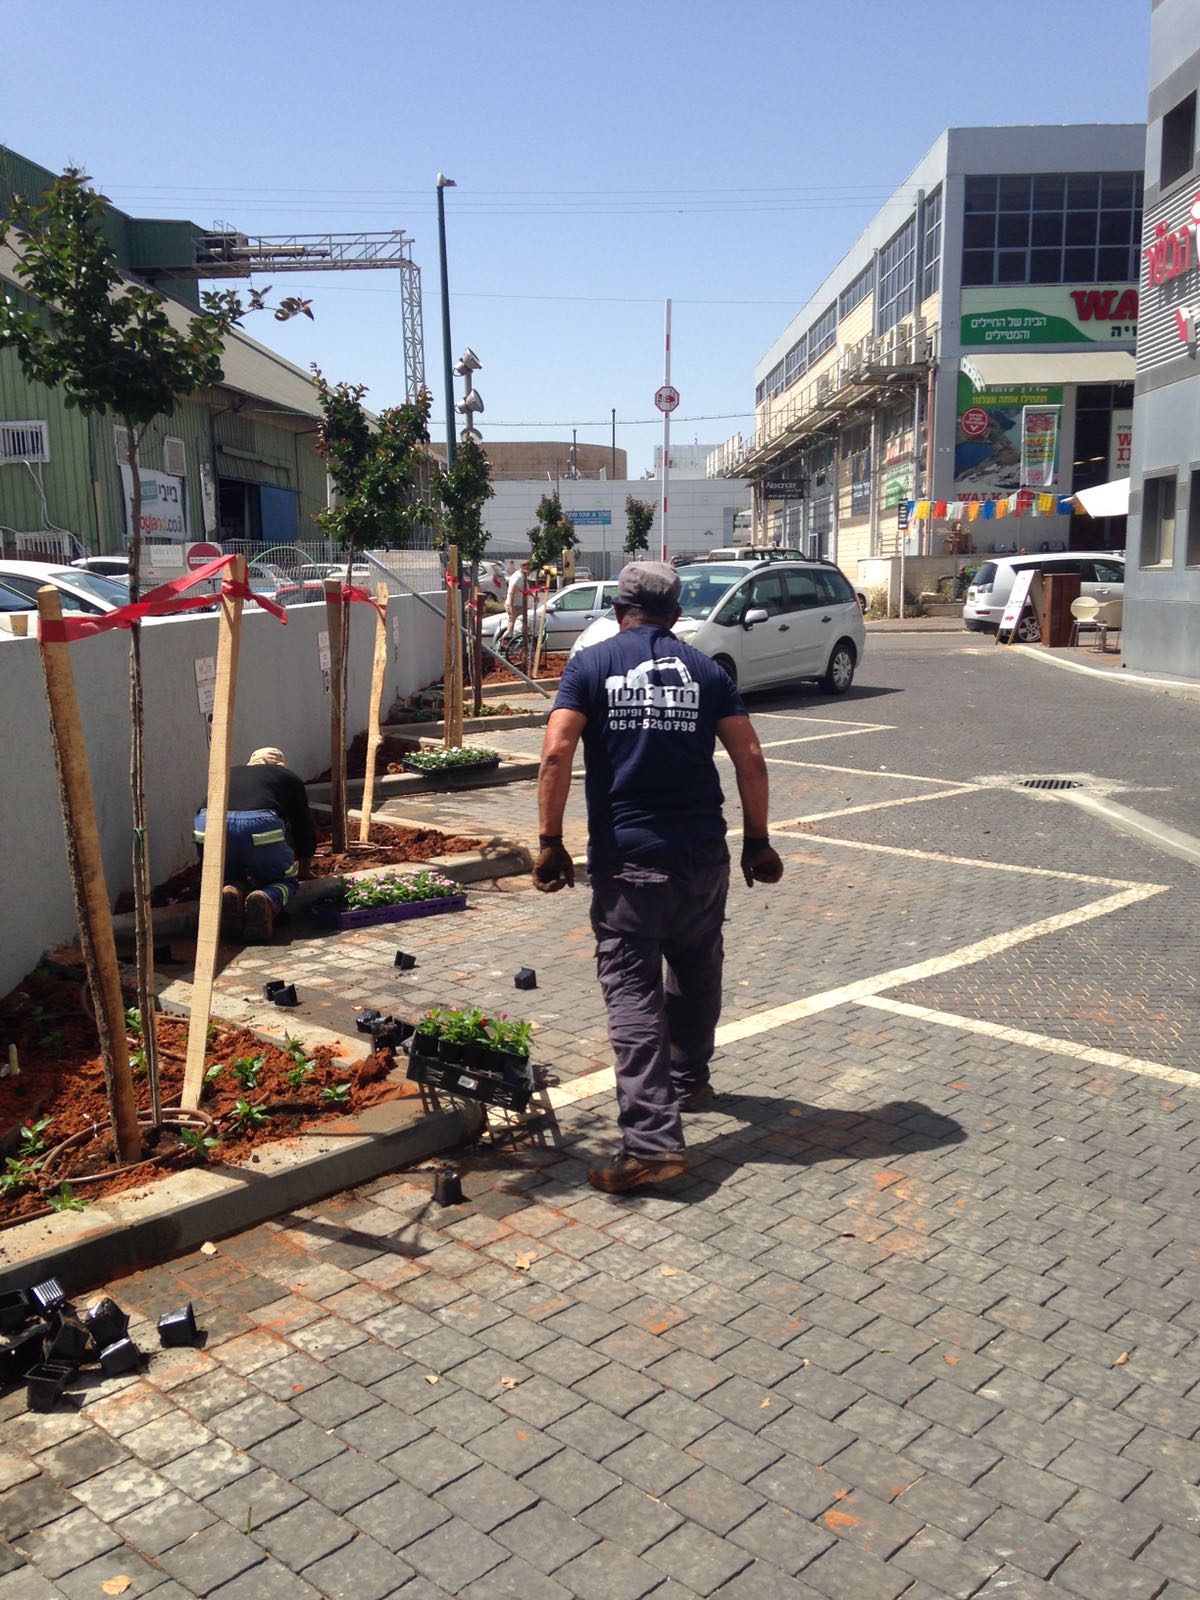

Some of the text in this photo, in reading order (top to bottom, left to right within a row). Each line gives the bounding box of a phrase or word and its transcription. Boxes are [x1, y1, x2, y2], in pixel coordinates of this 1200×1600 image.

[971, 317, 1047, 328] הבית של החיילים
[985, 330, 1030, 341] והמטיילים
[661, 688, 696, 703] רודי
[664, 709, 699, 719] עבודות
[609, 718, 696, 732] 054-5260798
